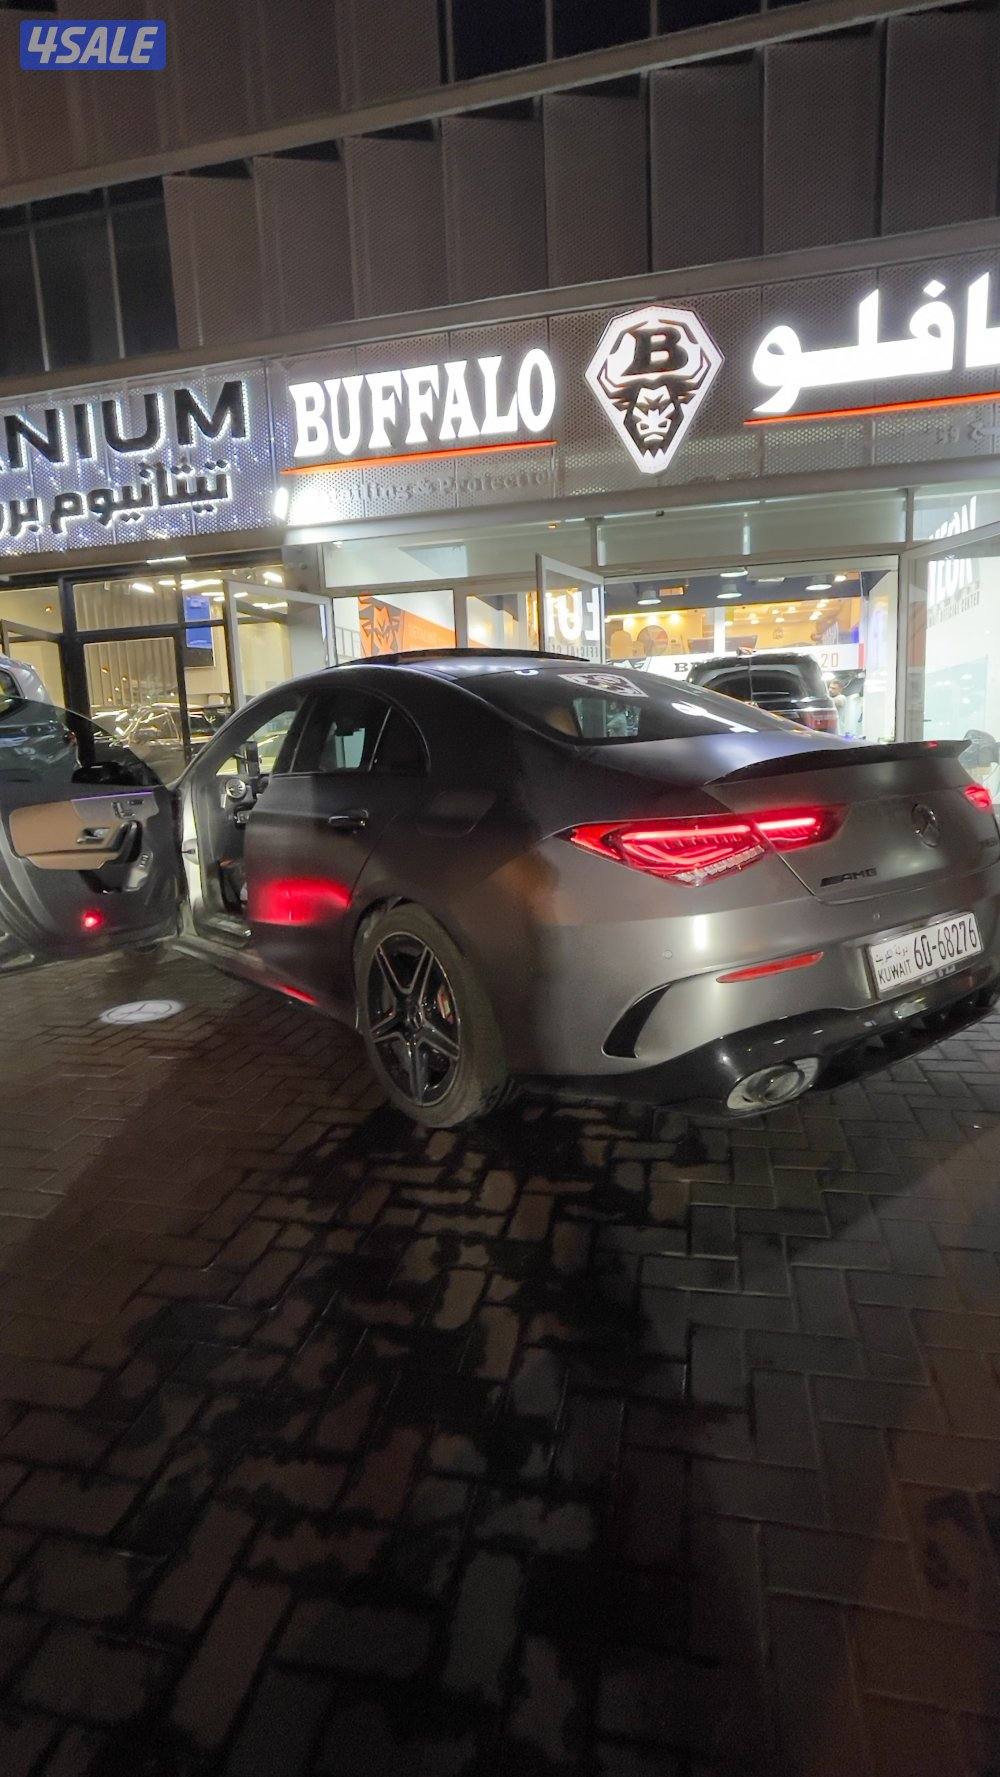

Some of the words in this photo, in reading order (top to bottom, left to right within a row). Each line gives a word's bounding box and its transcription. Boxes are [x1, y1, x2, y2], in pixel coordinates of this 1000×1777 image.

[0, 380, 247, 472] NIUM
[288, 348, 556, 457] BUFFALO
[50, 457, 230, 535] تيتانيوم
[877, 959, 912, 984] KUWAIT
[914, 918, 977, 970] 60-68276
